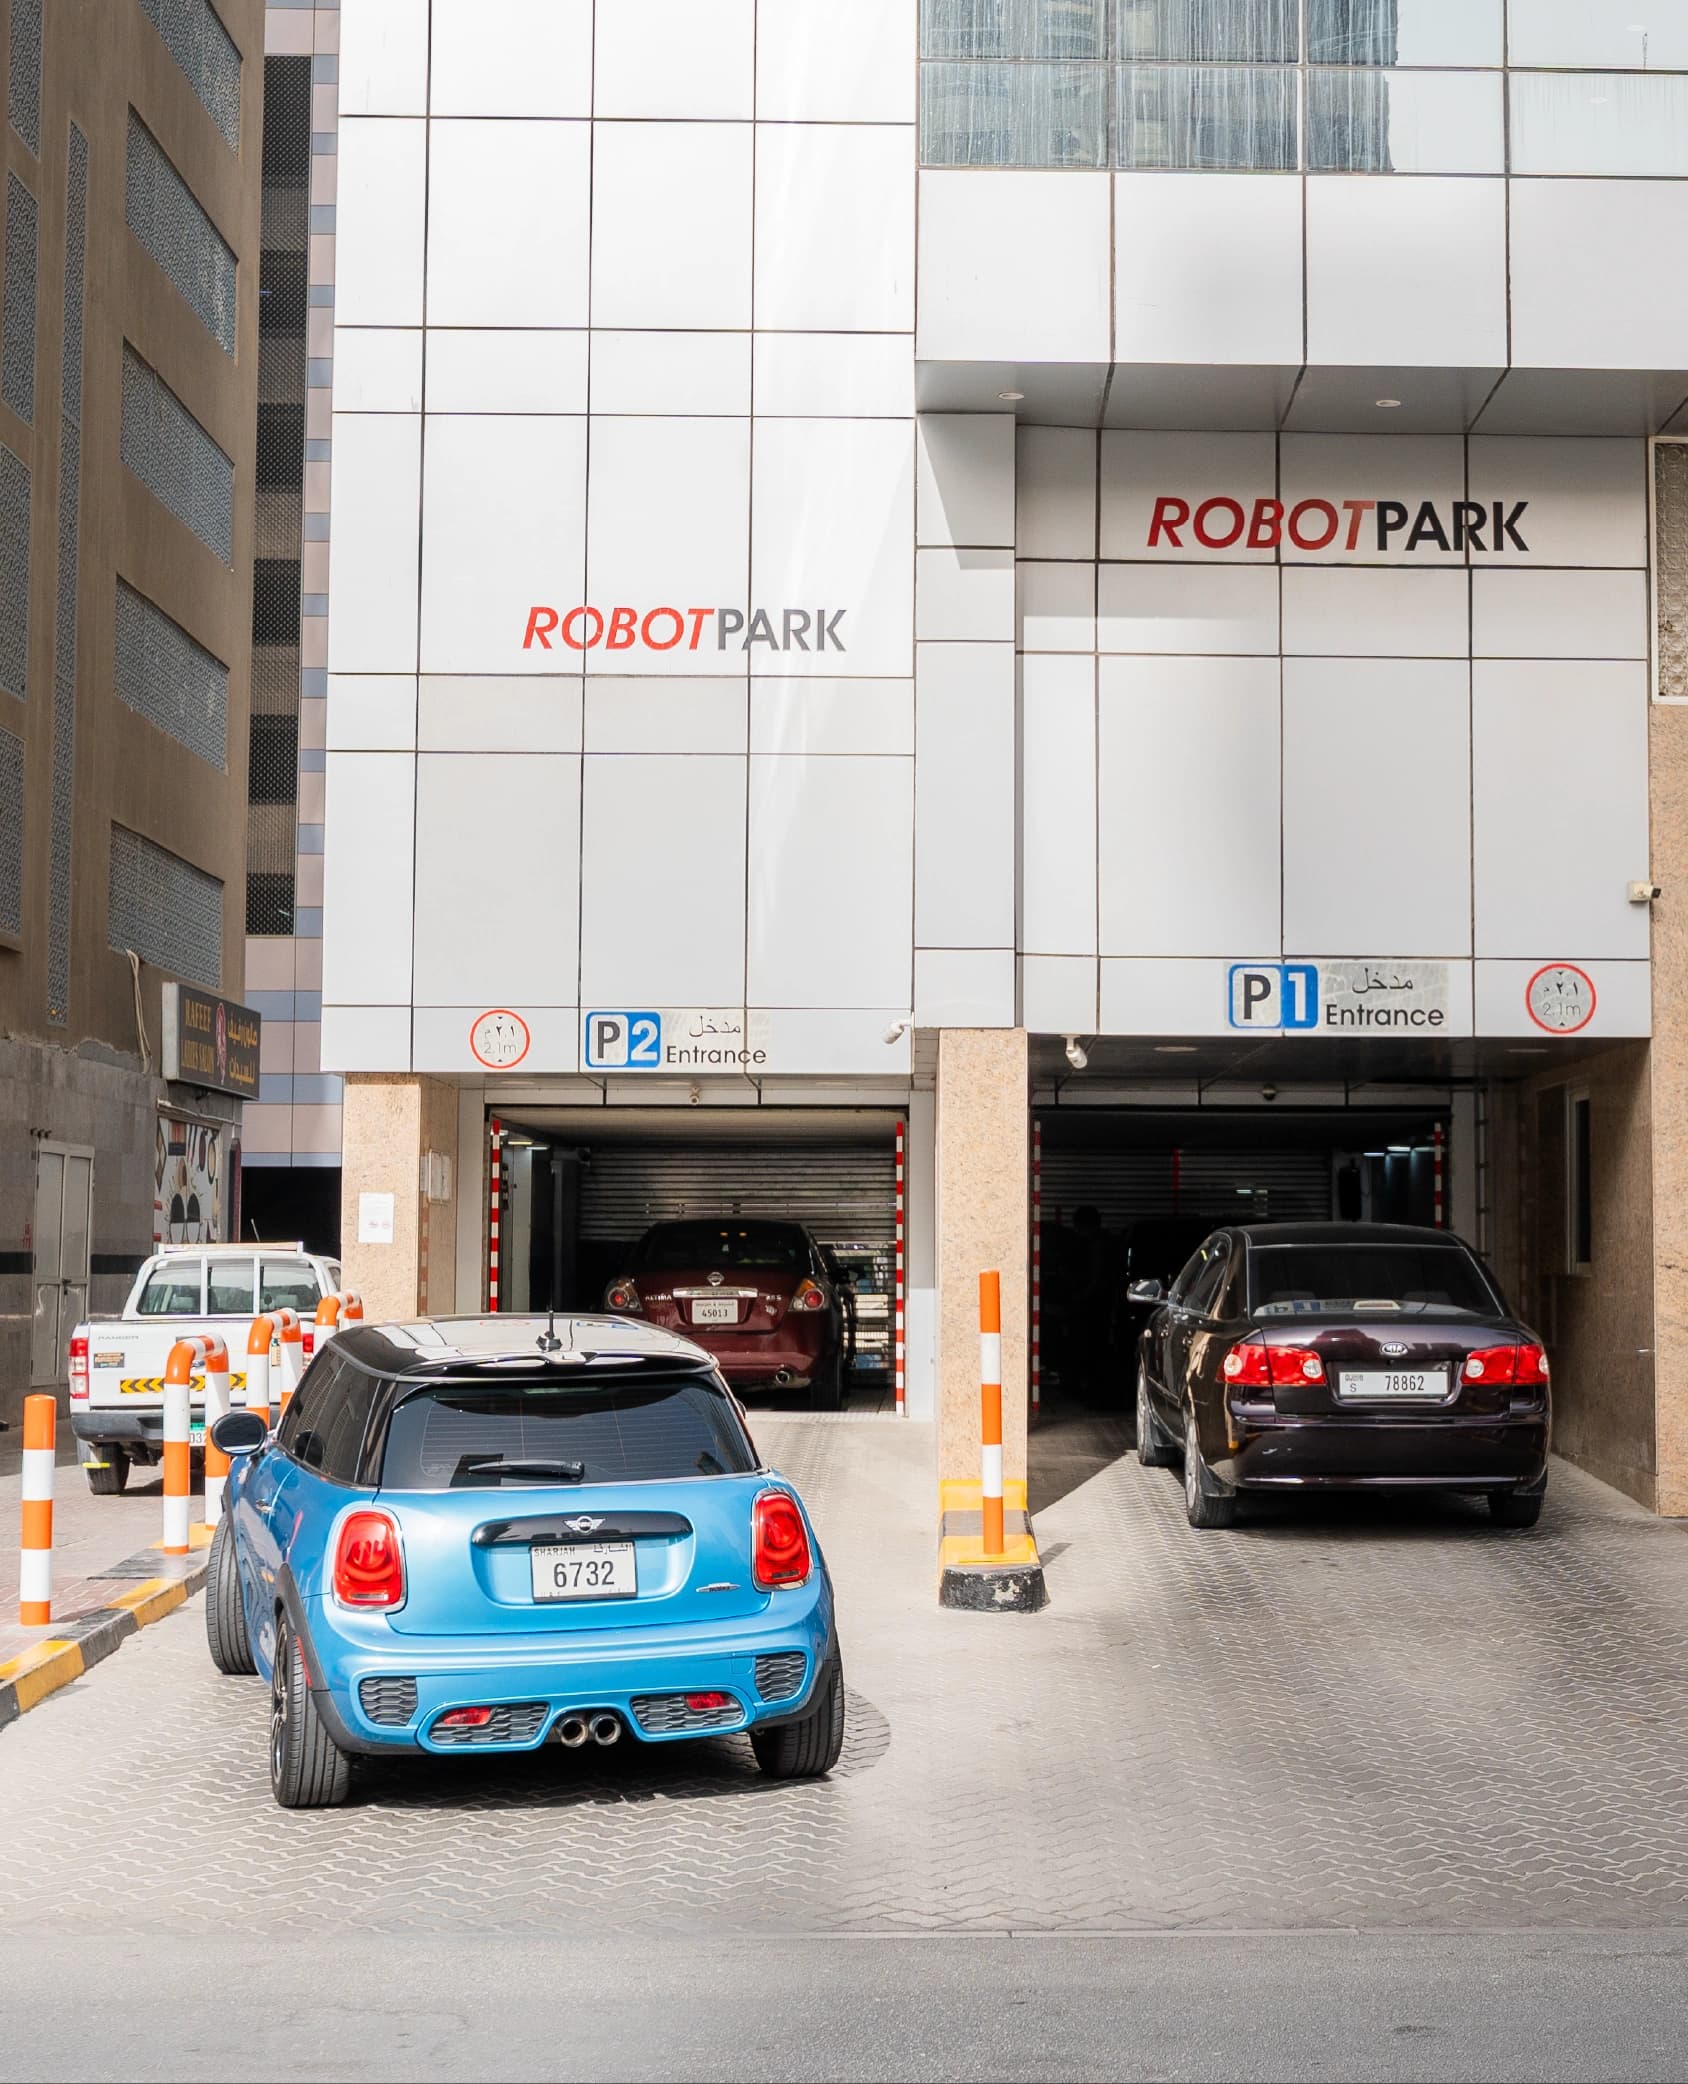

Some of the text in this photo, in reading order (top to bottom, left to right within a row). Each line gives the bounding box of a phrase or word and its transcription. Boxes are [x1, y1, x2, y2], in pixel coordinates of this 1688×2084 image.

[1147, 496, 1529, 551] ROBOTPARK
[522, 606, 847, 651] ROBOTPARK
[1352, 968, 1413, 993] مدخل
[1325, 1003, 1444, 1026] Entrance
[689, 1015, 741, 1037] مدخل
[666, 1045, 767, 1064] Entrance
[702, 1308, 728, 1318] 45013
[1350, 1383, 1357, 1393] S
[1385, 1375, 1425, 1391] 78862
[533, 1546, 576, 1557] SHARJAH
[553, 1560, 615, 1588] 6732
